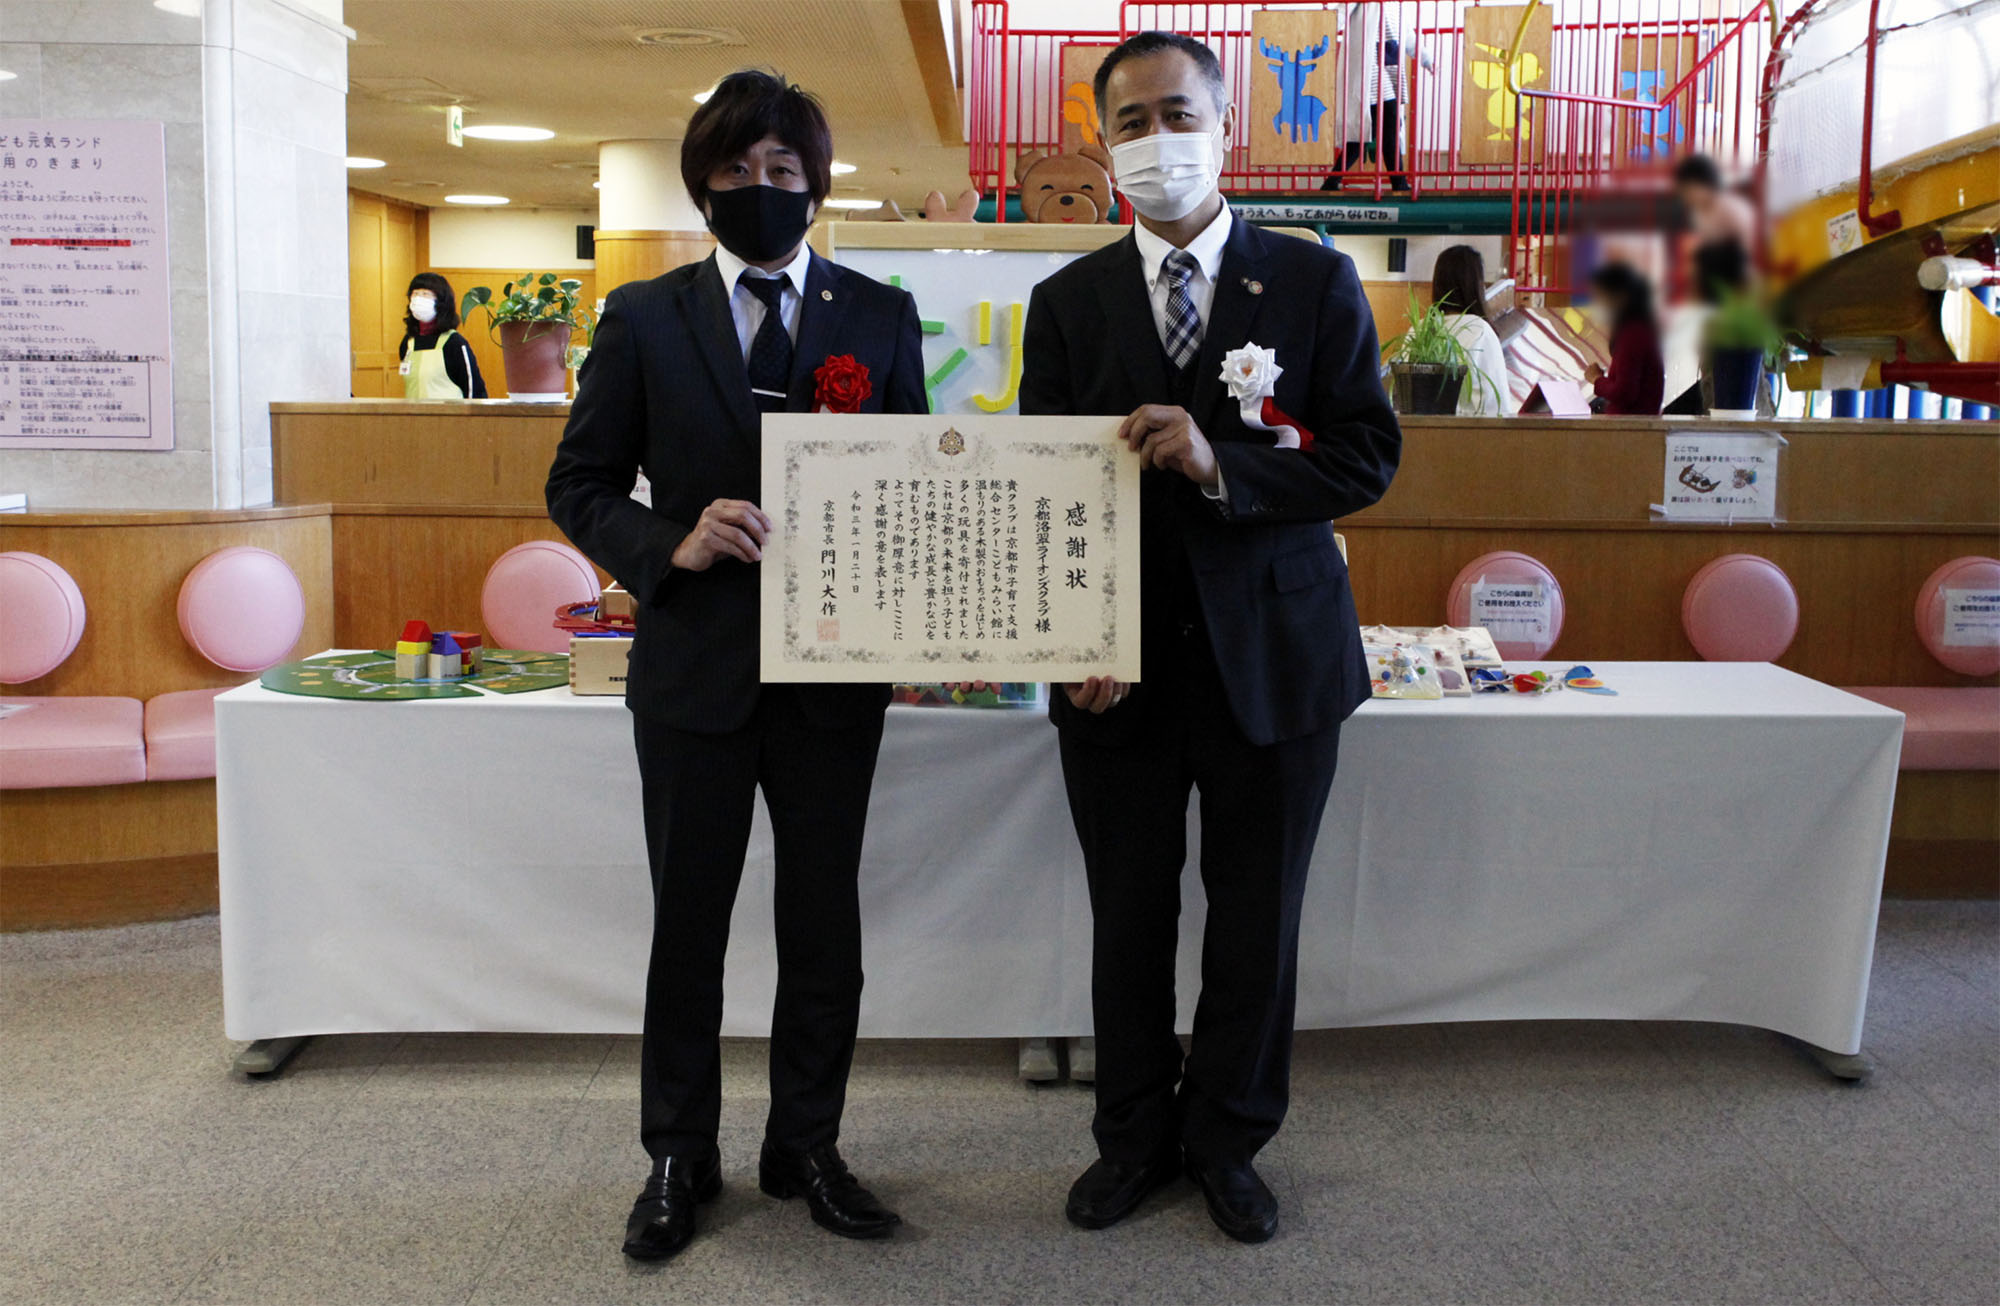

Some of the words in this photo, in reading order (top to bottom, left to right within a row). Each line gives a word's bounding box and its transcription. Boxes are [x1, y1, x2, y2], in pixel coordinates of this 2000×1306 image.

[850, 489, 862, 594] 令和三年一月二十日
[873, 479, 889, 611] 深く感謝の意を表します
[891, 479, 906, 641] よってその御厚意に対しここに
[908, 479, 922, 581] 育むものであります
[923, 479, 938, 641] たちの健やかな成長と豊かな心を
[941, 479, 955, 640] これは京都の未来を担う子ども
[957, 479, 971, 640] 多くの玩具を寄付されました
[974, 479, 987, 640] 温もりのある木製のおもちゃをはじめ
[989, 479, 1003, 640] 総合センターこどもみらい館に
[1005, 479, 1019, 640] 貴クラブは京都市子育て支援
[1064, 501, 1089, 590] 感謝状
